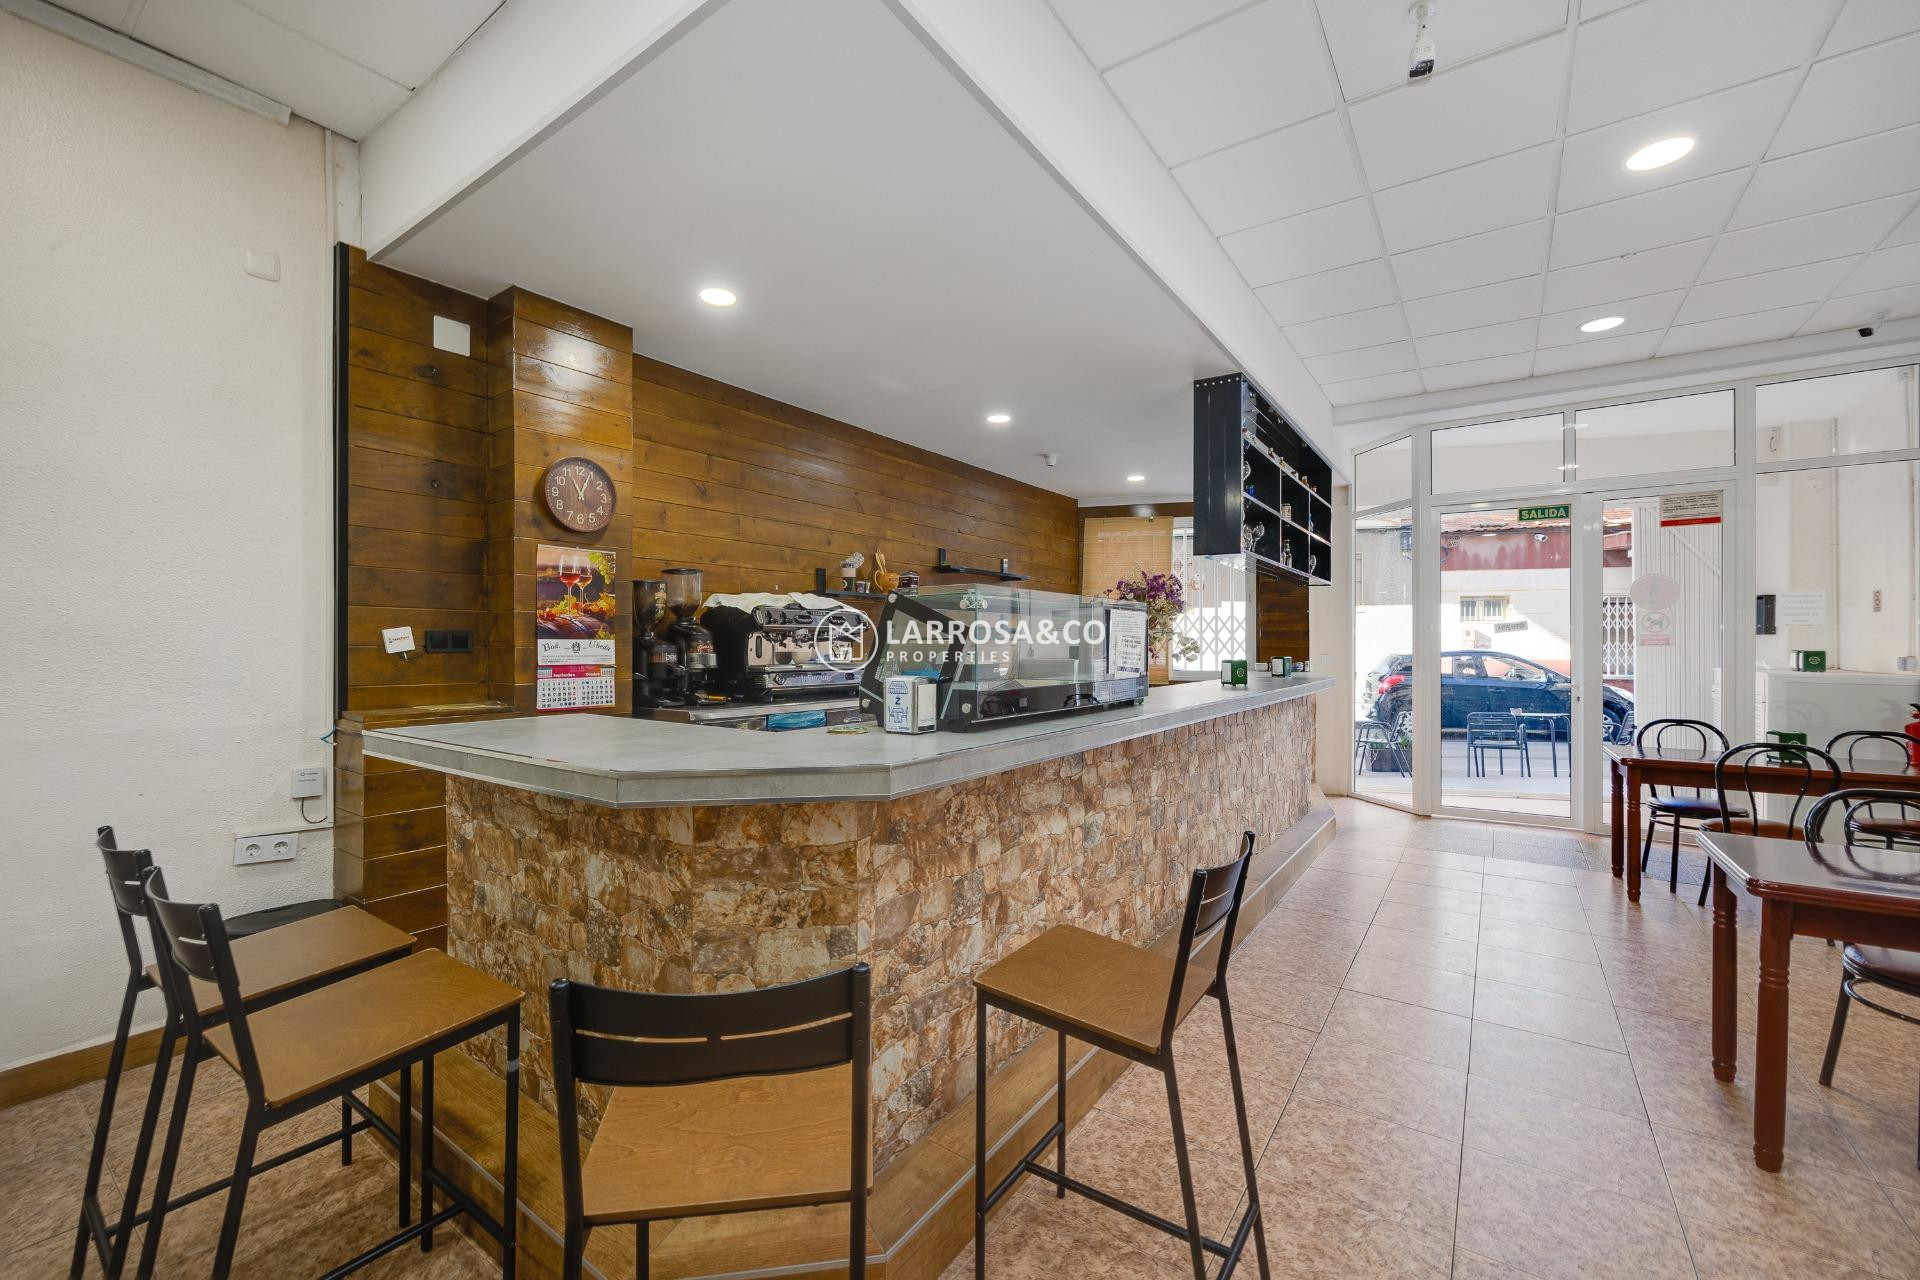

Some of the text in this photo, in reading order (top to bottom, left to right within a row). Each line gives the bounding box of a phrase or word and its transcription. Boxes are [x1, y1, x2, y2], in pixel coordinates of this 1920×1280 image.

[562, 467, 572, 477] 11
[574, 465, 585, 476] 12
[554, 475, 566, 486] 10
[596, 481, 604, 491] 2
[551, 486, 559, 497] 9
[600, 493, 608, 504] 3
[556, 499, 564, 510] 8
[566, 510, 574, 521] 7
[596, 505, 604, 516] 4
[1521, 507, 1567, 519] SALIDA
[576, 513, 585, 525] 6
[588, 512, 596, 523] 5
